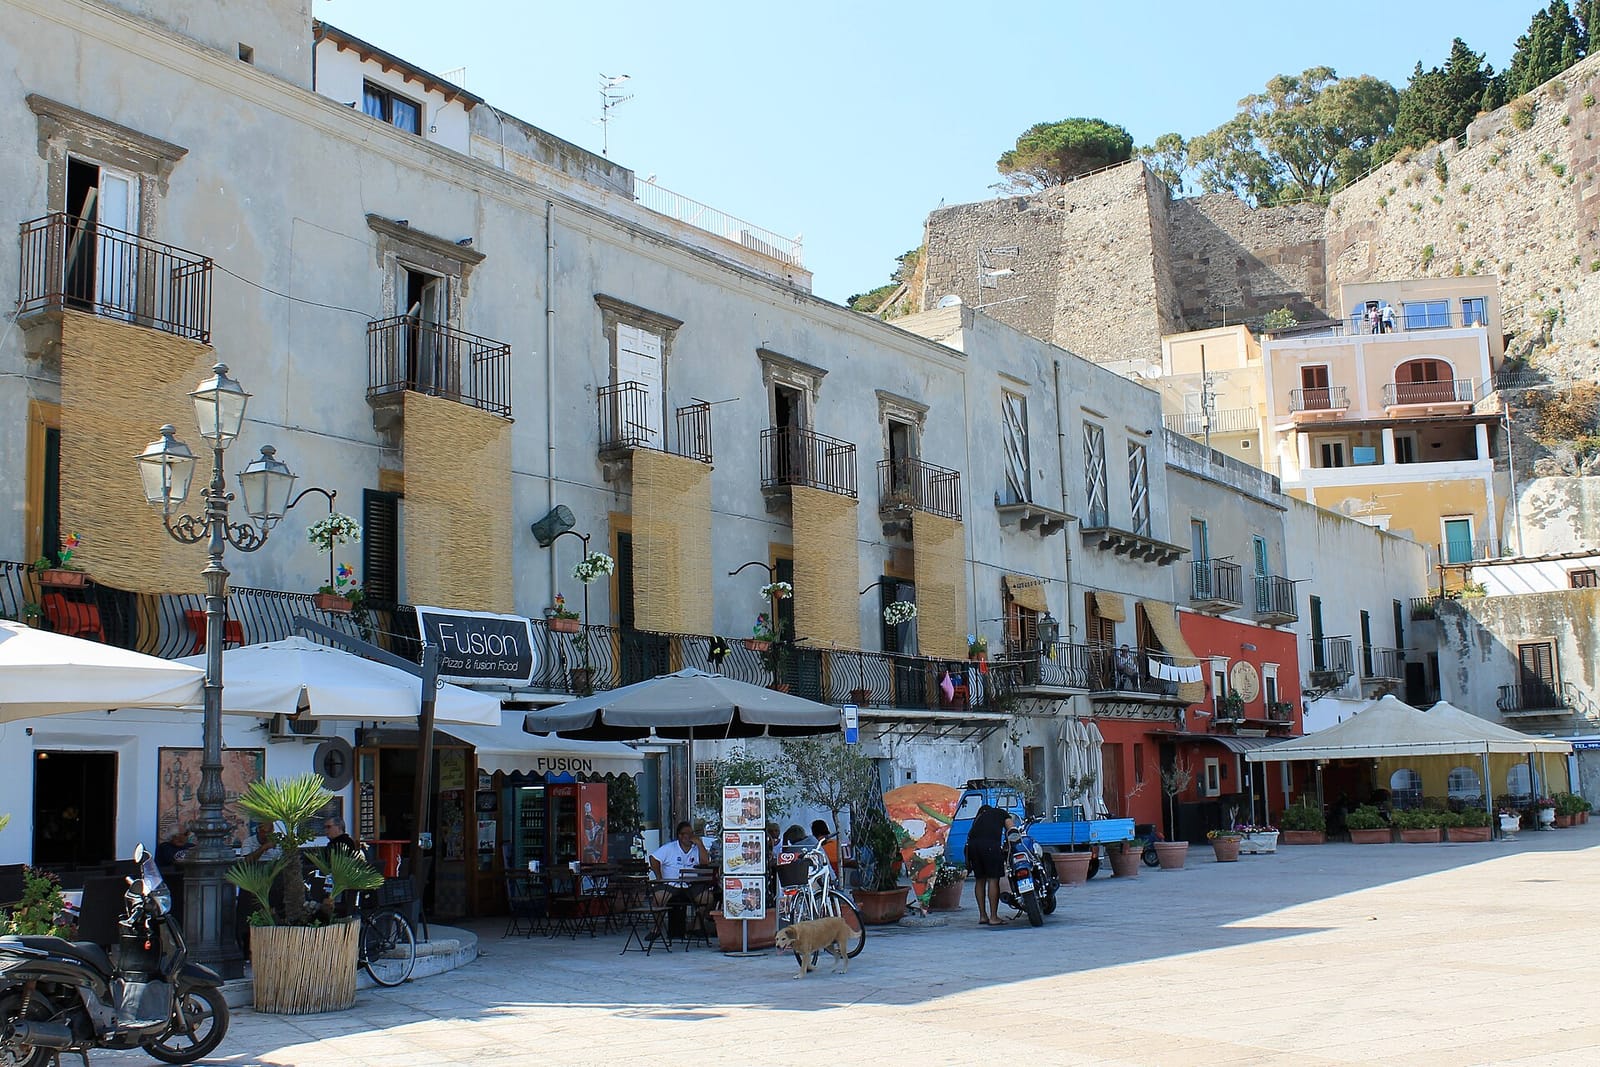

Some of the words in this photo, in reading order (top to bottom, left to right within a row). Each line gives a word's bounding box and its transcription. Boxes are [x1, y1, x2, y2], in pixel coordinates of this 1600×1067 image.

[438, 623, 519, 657] Fusion
[441, 657, 464, 669] Pizza
[465, 658, 472, 669] &
[473, 659, 497, 671] fusion
[497, 660, 519, 672] Food
[537, 757, 593, 771] FUSION
